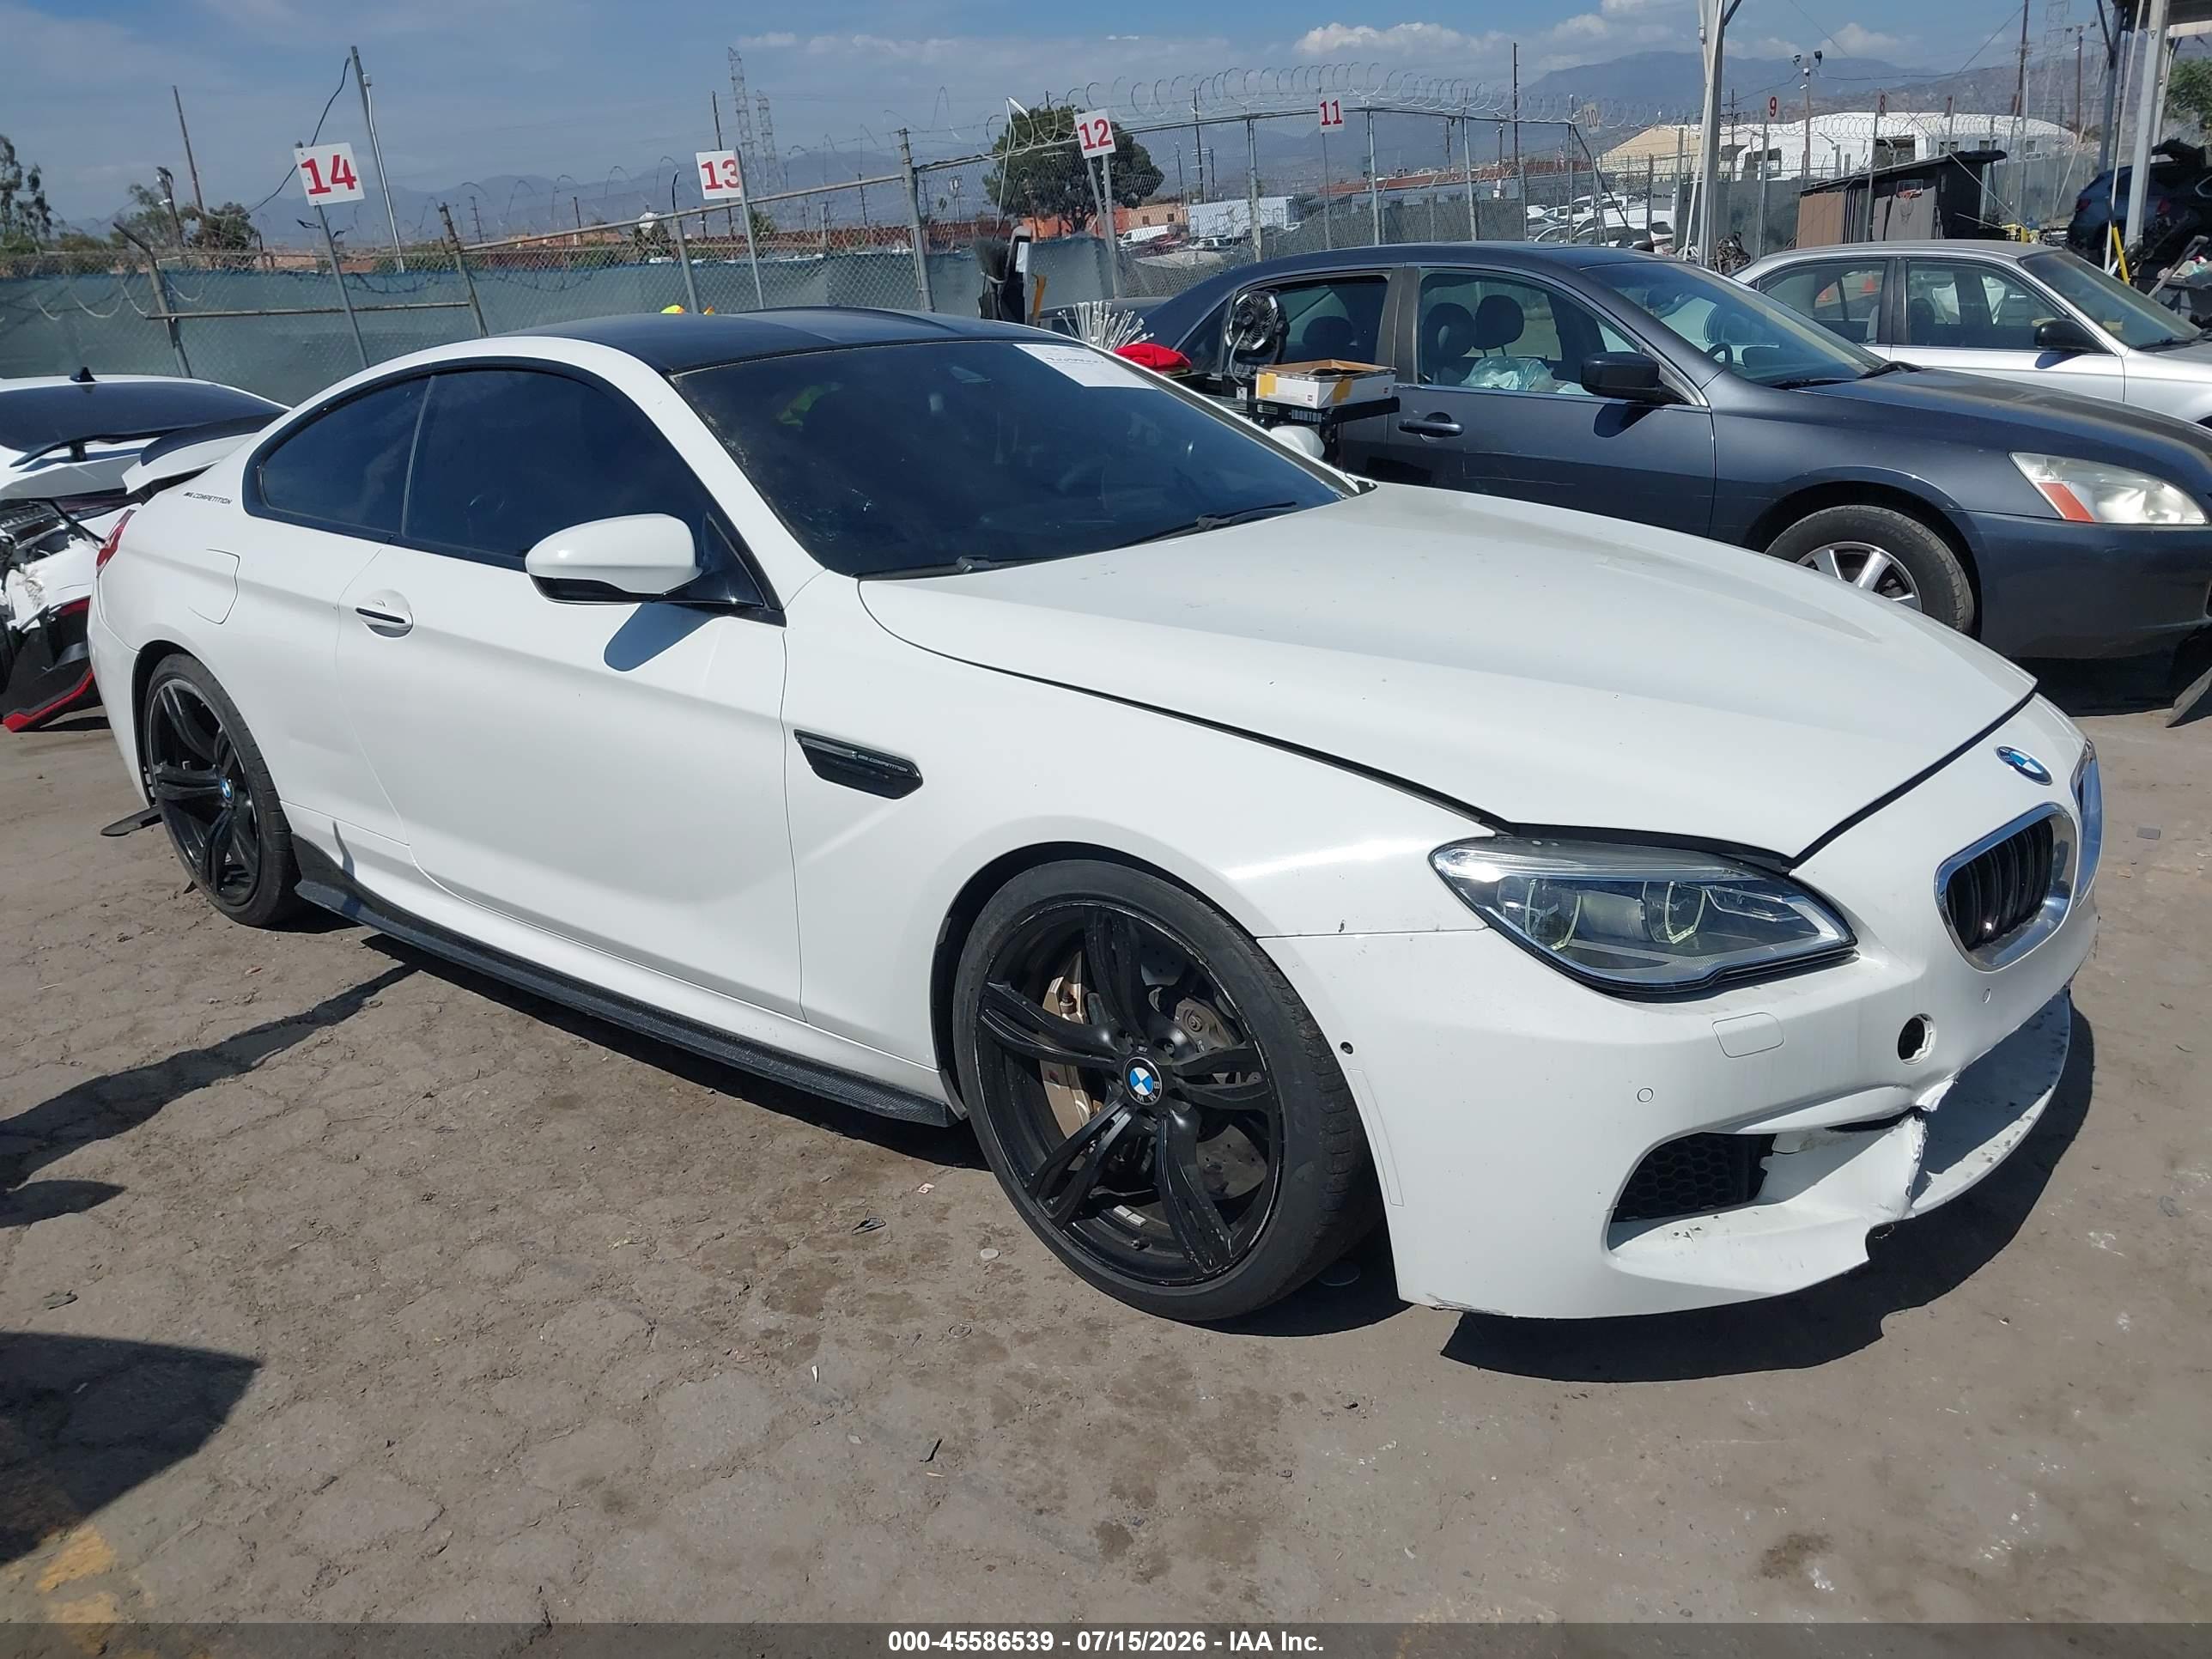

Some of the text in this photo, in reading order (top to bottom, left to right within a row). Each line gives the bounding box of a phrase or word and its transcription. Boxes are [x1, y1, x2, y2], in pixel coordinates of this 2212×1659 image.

[1320, 99, 1342, 125] 11
[1770, 96, 1777, 117] 9
[1880, 94, 1886, 113] 8
[1586, 109, 1597, 128] 10
[1079, 118, 1113, 150] 12
[301, 155, 357, 194] 14
[701, 159, 740, 190] 13
